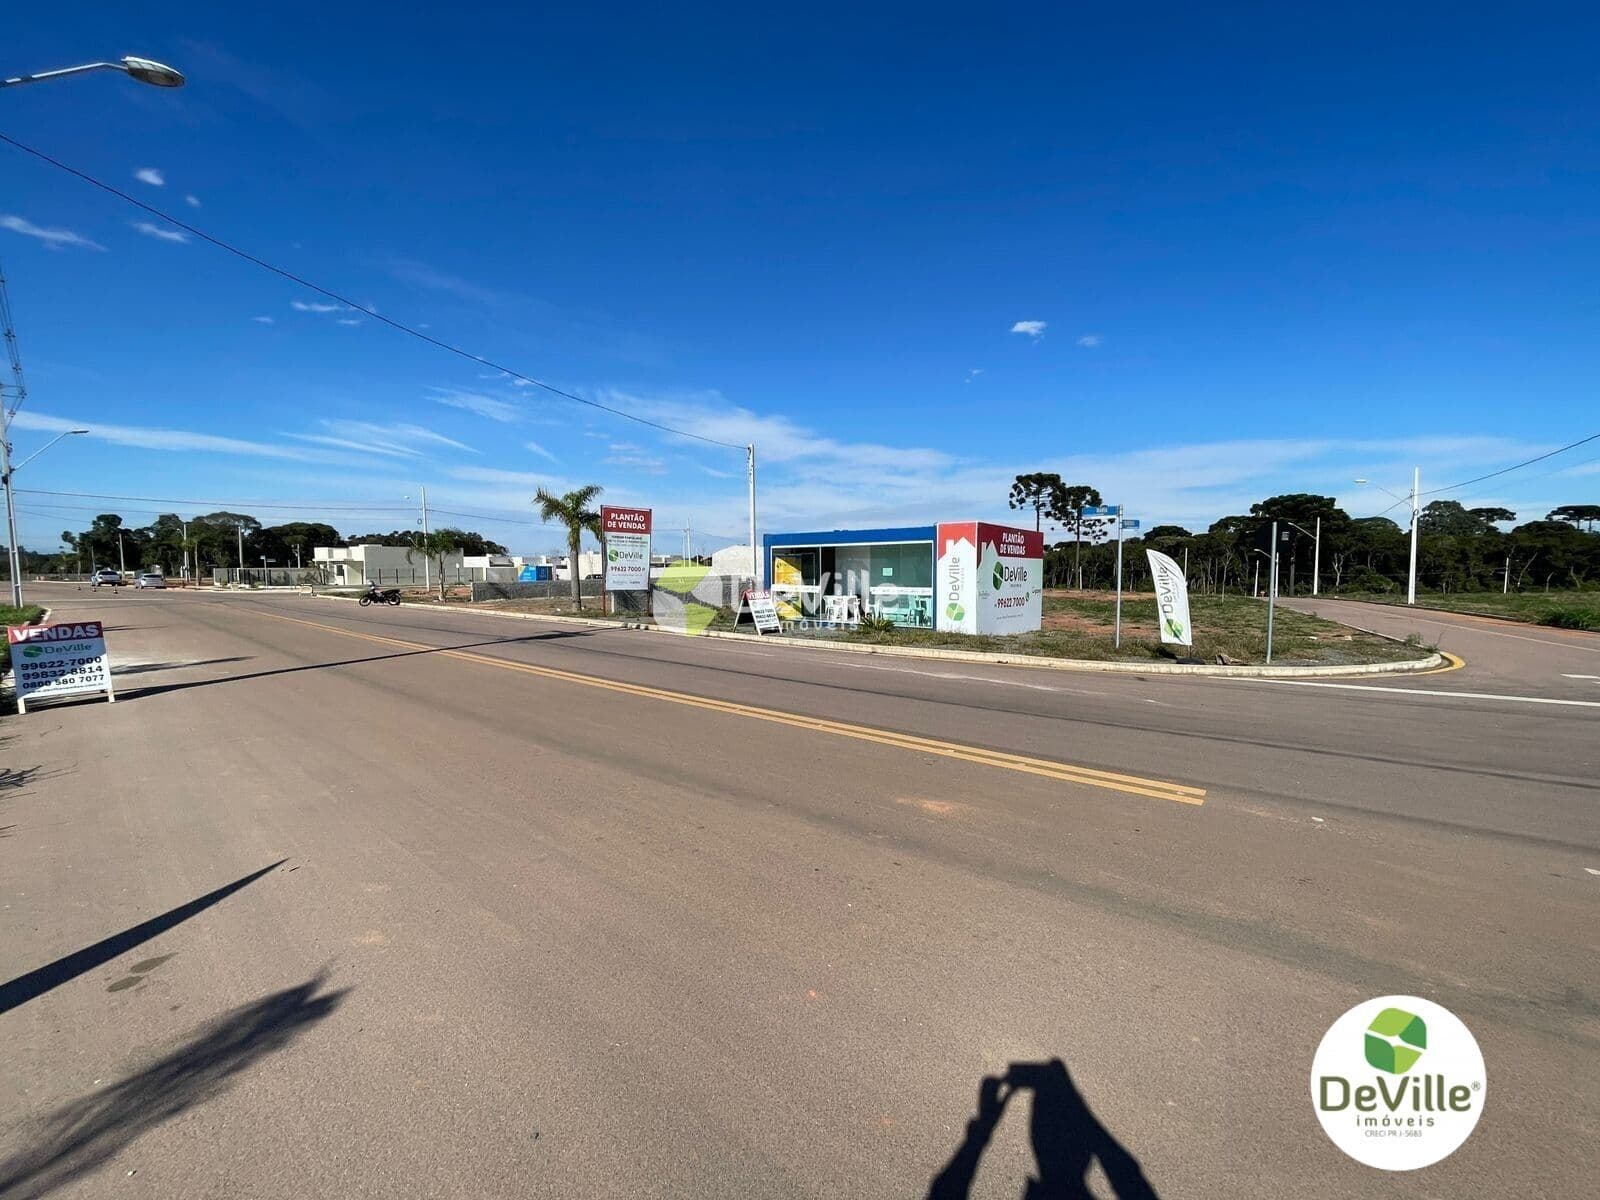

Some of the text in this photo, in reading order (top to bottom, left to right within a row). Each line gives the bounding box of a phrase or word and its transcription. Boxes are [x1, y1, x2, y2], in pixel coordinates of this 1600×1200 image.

[610, 512, 645, 522] PLANTÃO
[617, 522, 646, 530] VENDAS
[1002, 531, 1025, 544] PLANTÃO
[619, 551, 644, 560] DeVille
[1000, 544, 1026, 555] DE VENDAS
[949, 556, 960, 601] DeVille
[1004, 566, 1028, 582] DeVille
[1157, 567, 1174, 614] DeVille
[12, 624, 99, 642] VENDAS
[44, 642, 92, 654] DeVille
[20, 656, 102, 671] 99622-7000
[23, 680, 52, 689] 0800
[55, 677, 75, 686] 580
[79, 674, 105, 685] 7077
